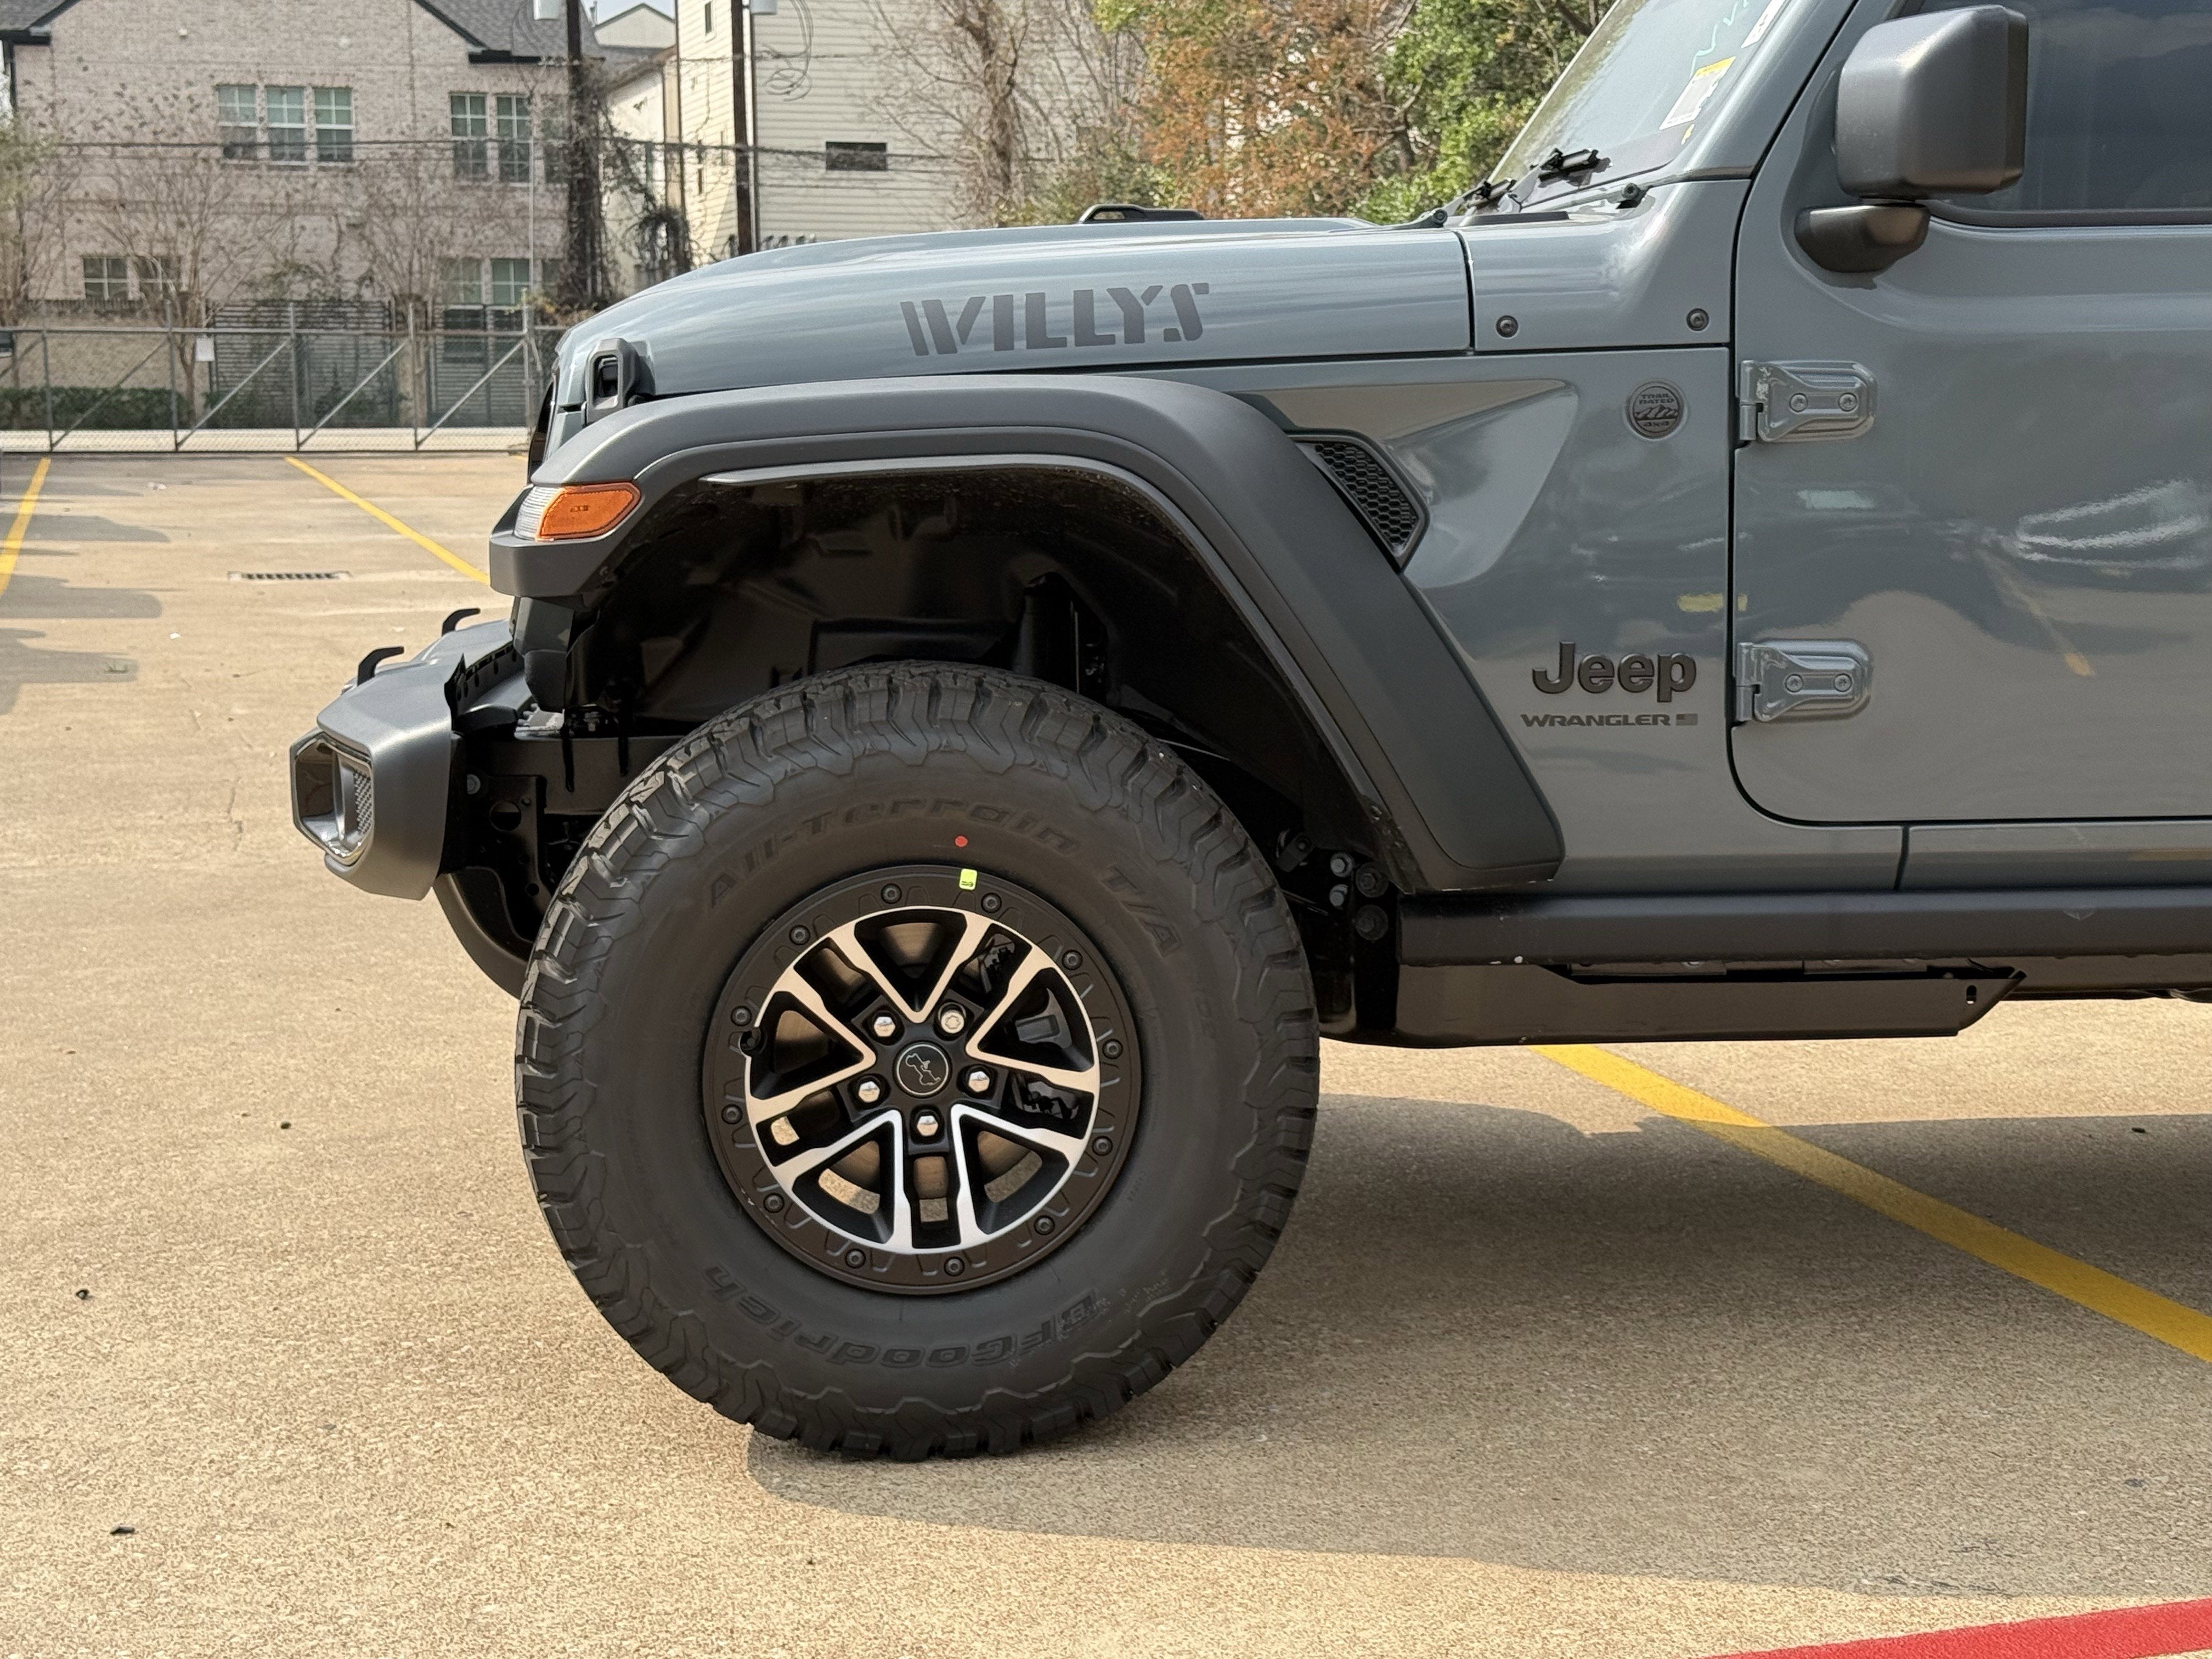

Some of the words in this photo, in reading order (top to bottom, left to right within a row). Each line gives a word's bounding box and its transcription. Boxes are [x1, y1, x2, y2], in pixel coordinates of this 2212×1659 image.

[900, 283, 1209, 356] WILLYS
[1532, 641, 1697, 703] Jeep
[1520, 713, 1671, 727] WRANGLER
[708, 797, 1084, 911] All-Terrain
